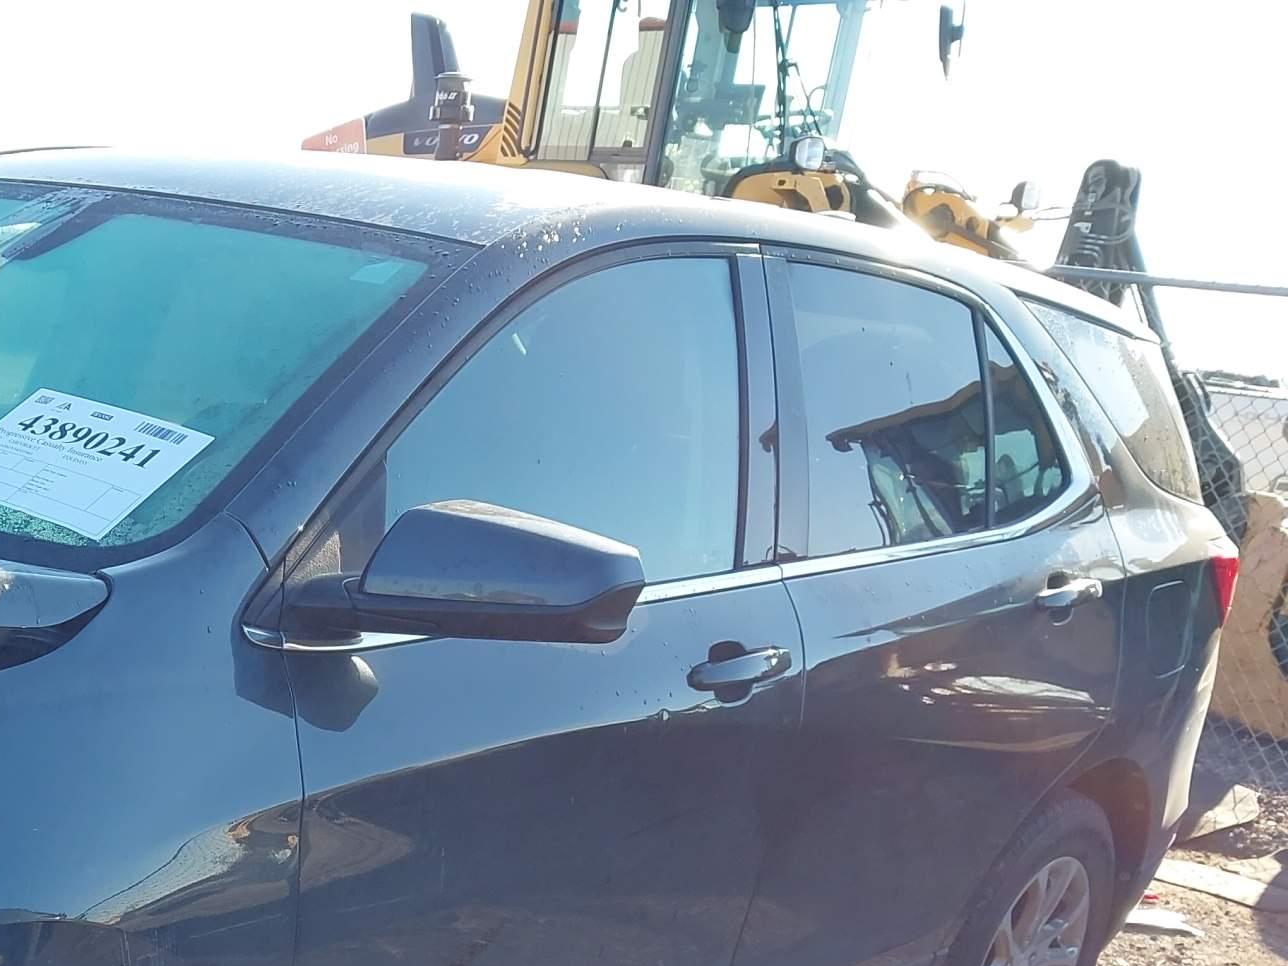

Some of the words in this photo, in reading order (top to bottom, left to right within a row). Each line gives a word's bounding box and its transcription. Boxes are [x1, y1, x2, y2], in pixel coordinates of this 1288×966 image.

[325, 134, 338, 146] No
[17, 414, 162, 469] 43890241
[37, 438, 66, 453] Casualty
[67, 446, 104, 463] Insurance
